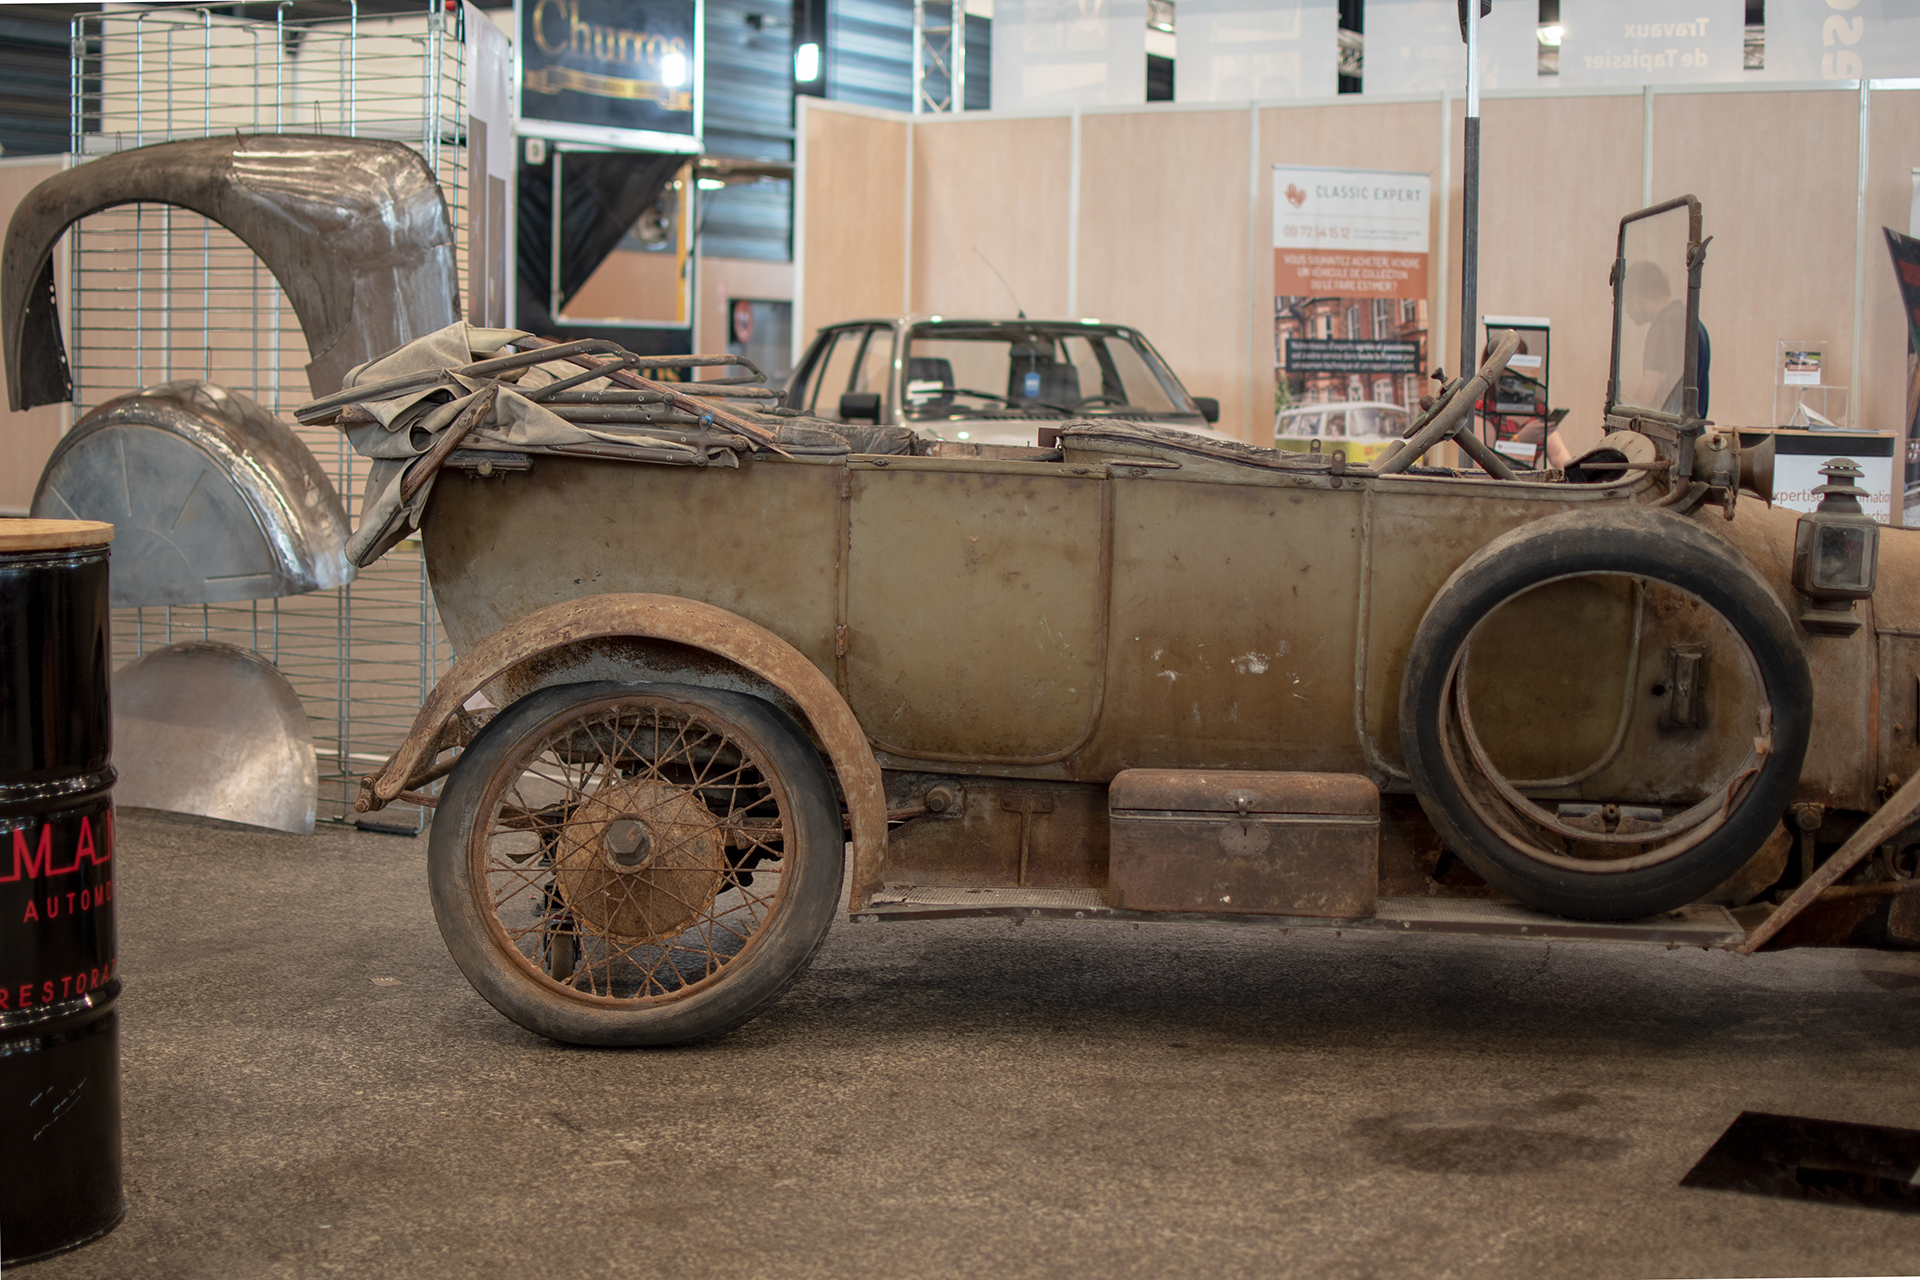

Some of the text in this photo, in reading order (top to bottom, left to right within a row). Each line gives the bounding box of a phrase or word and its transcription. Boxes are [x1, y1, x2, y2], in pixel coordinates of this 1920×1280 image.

[1316, 185, 1421, 202] CLASSIC EXPERT
[1772, 489, 1824, 505] xpertise
[0, 956, 116, 1010] RESTORA
